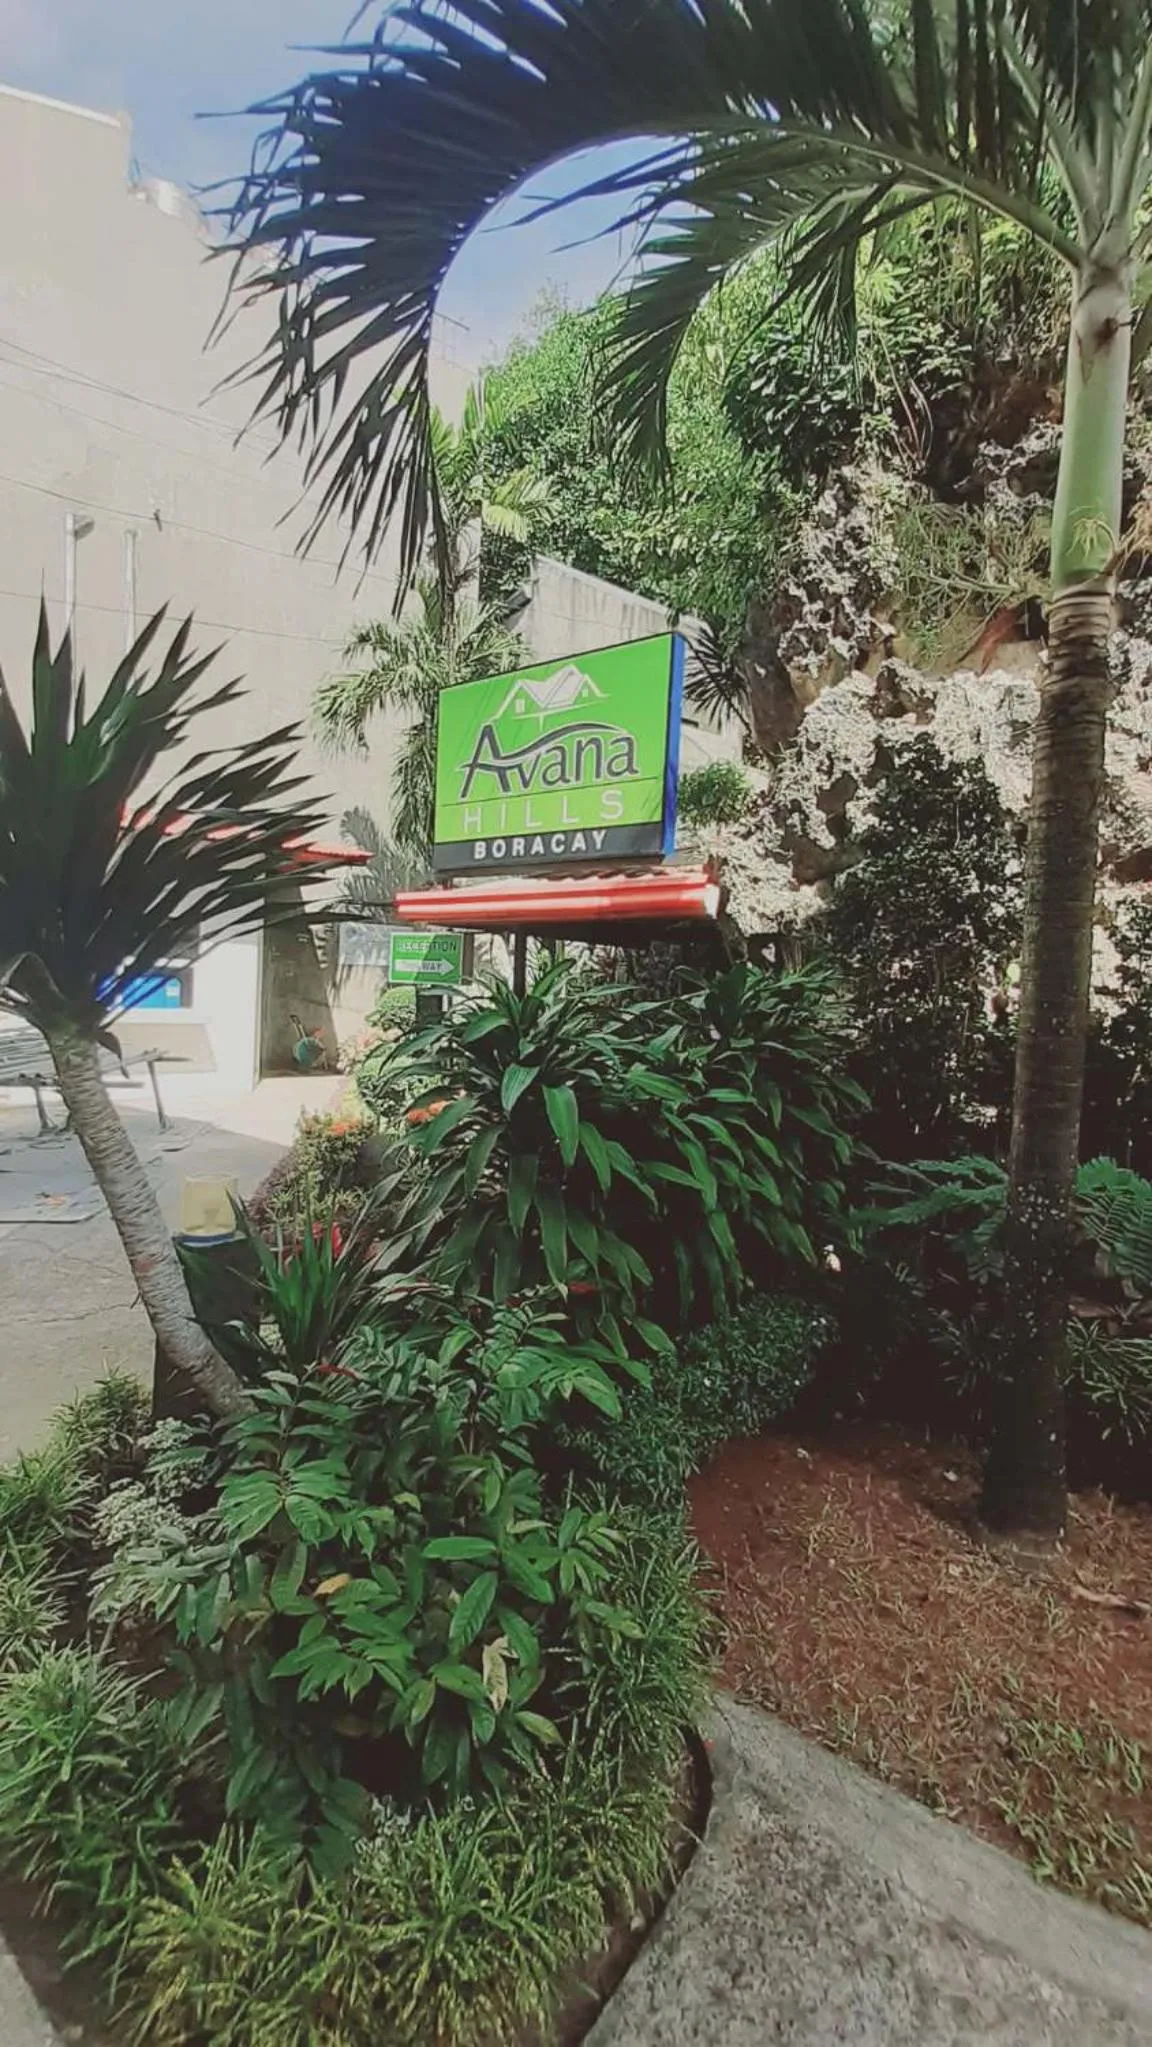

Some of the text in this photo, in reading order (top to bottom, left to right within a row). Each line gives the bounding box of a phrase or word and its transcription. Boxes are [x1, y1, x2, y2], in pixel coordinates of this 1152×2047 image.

[458, 722, 639, 799] Avana
[463, 790, 625, 834] HILLS
[474, 830, 608, 860] BORACAY
